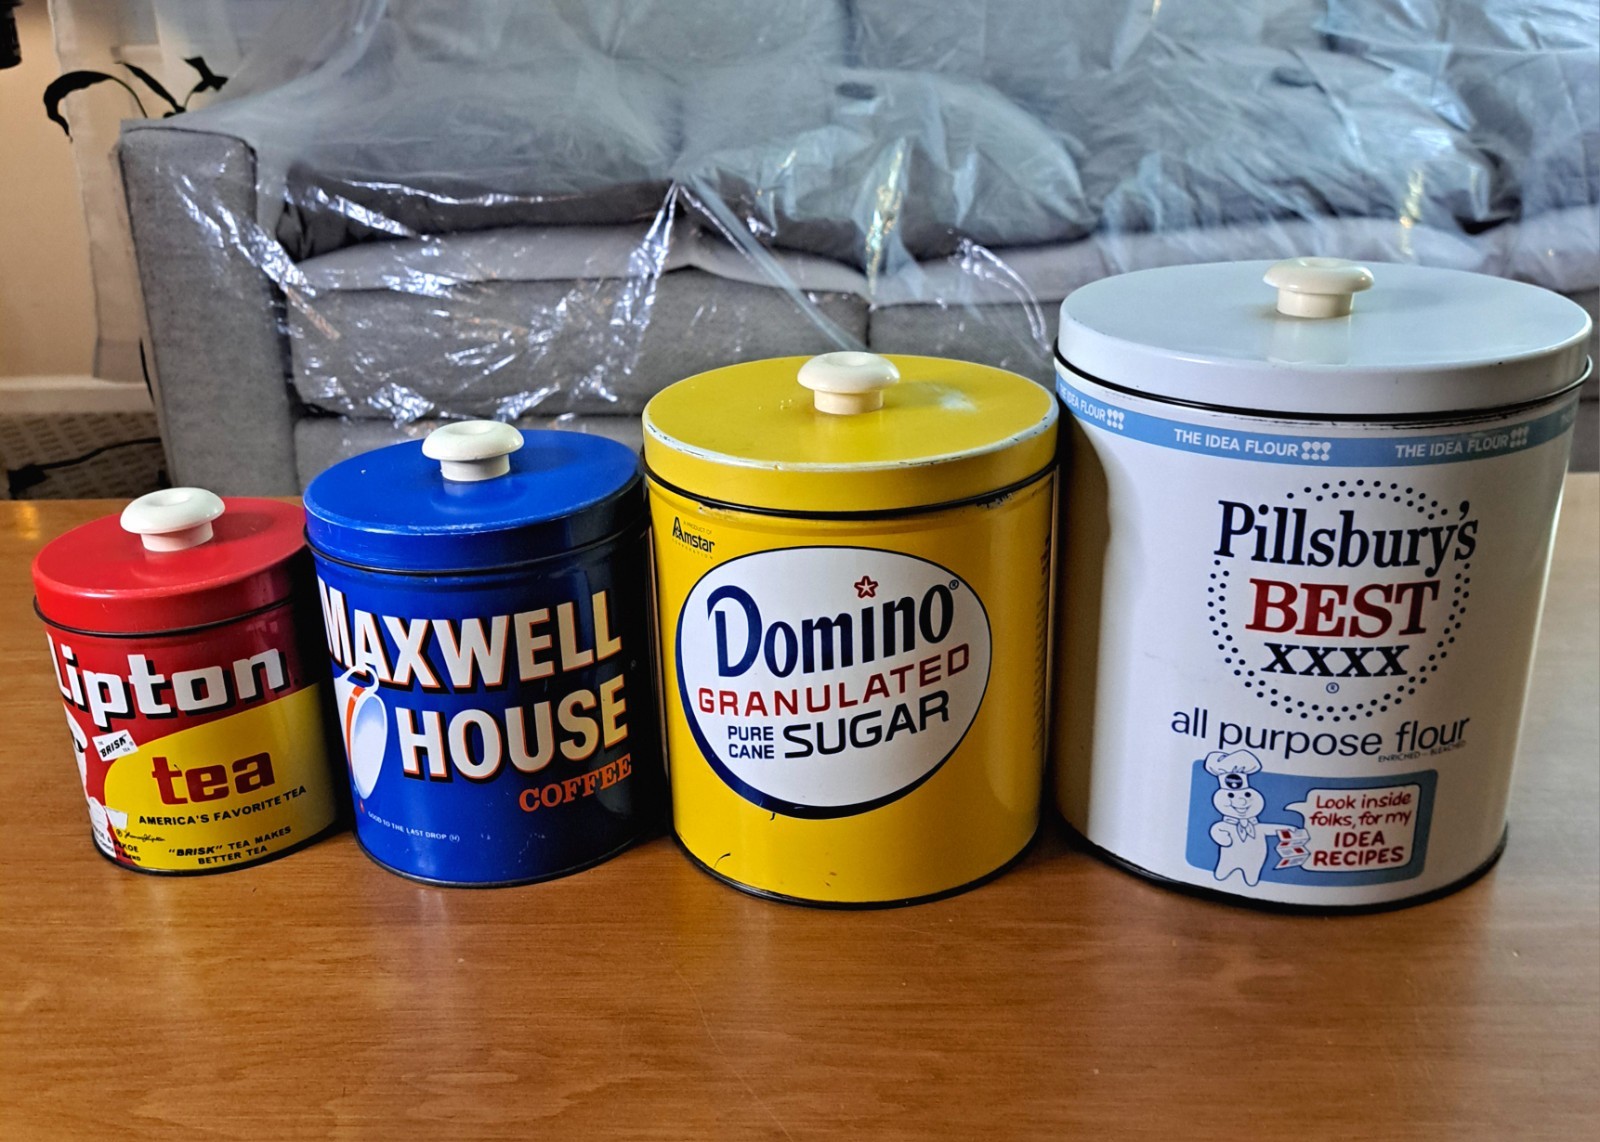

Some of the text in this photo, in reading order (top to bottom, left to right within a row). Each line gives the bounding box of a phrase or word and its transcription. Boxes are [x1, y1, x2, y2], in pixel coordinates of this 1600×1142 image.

[1174, 428, 1201, 445] THE
[1205, 434, 1240, 451] IDEA
[1395, 444, 1426, 458] THE
[1430, 440, 1462, 457] IDEA
[672, 516, 715, 553] Amstar
[1213, 499, 1479, 577] Pillsbury's
[1244, 578, 1441, 638] BEST
[317, 574, 622, 689] MAXWELL
[1260, 642, 1410, 678] XXXX
[45, 632, 286, 728] Lipton
[698, 642, 970, 717] GRANULATED
[395, 674, 629, 780] HOUSE
[727, 725, 774, 742] PURE
[783, 690, 949, 759] SUGAR
[1171, 707, 1471, 760] all purpose flour
[728, 743, 775, 760] CANE
[151, 752, 276, 805] tea
[518, 753, 632, 812] COFFEE
[139, 785, 307, 826] AMERICA'S FAVORITE TEA
[1309, 809, 1412, 829] folks, for my
[1316, 792, 1412, 810] Look inside
[228, 839, 250, 851] TEA
[254, 826, 292, 844] MAKES
[391, 822, 405, 833] THE
[406, 827, 423, 837] LAST
[425, 831, 447, 840] DROP
[1334, 830, 1385, 848] IDEA
[197, 845, 268, 865] BETTER TEA
[1313, 846, 1405, 867] RECIPES
